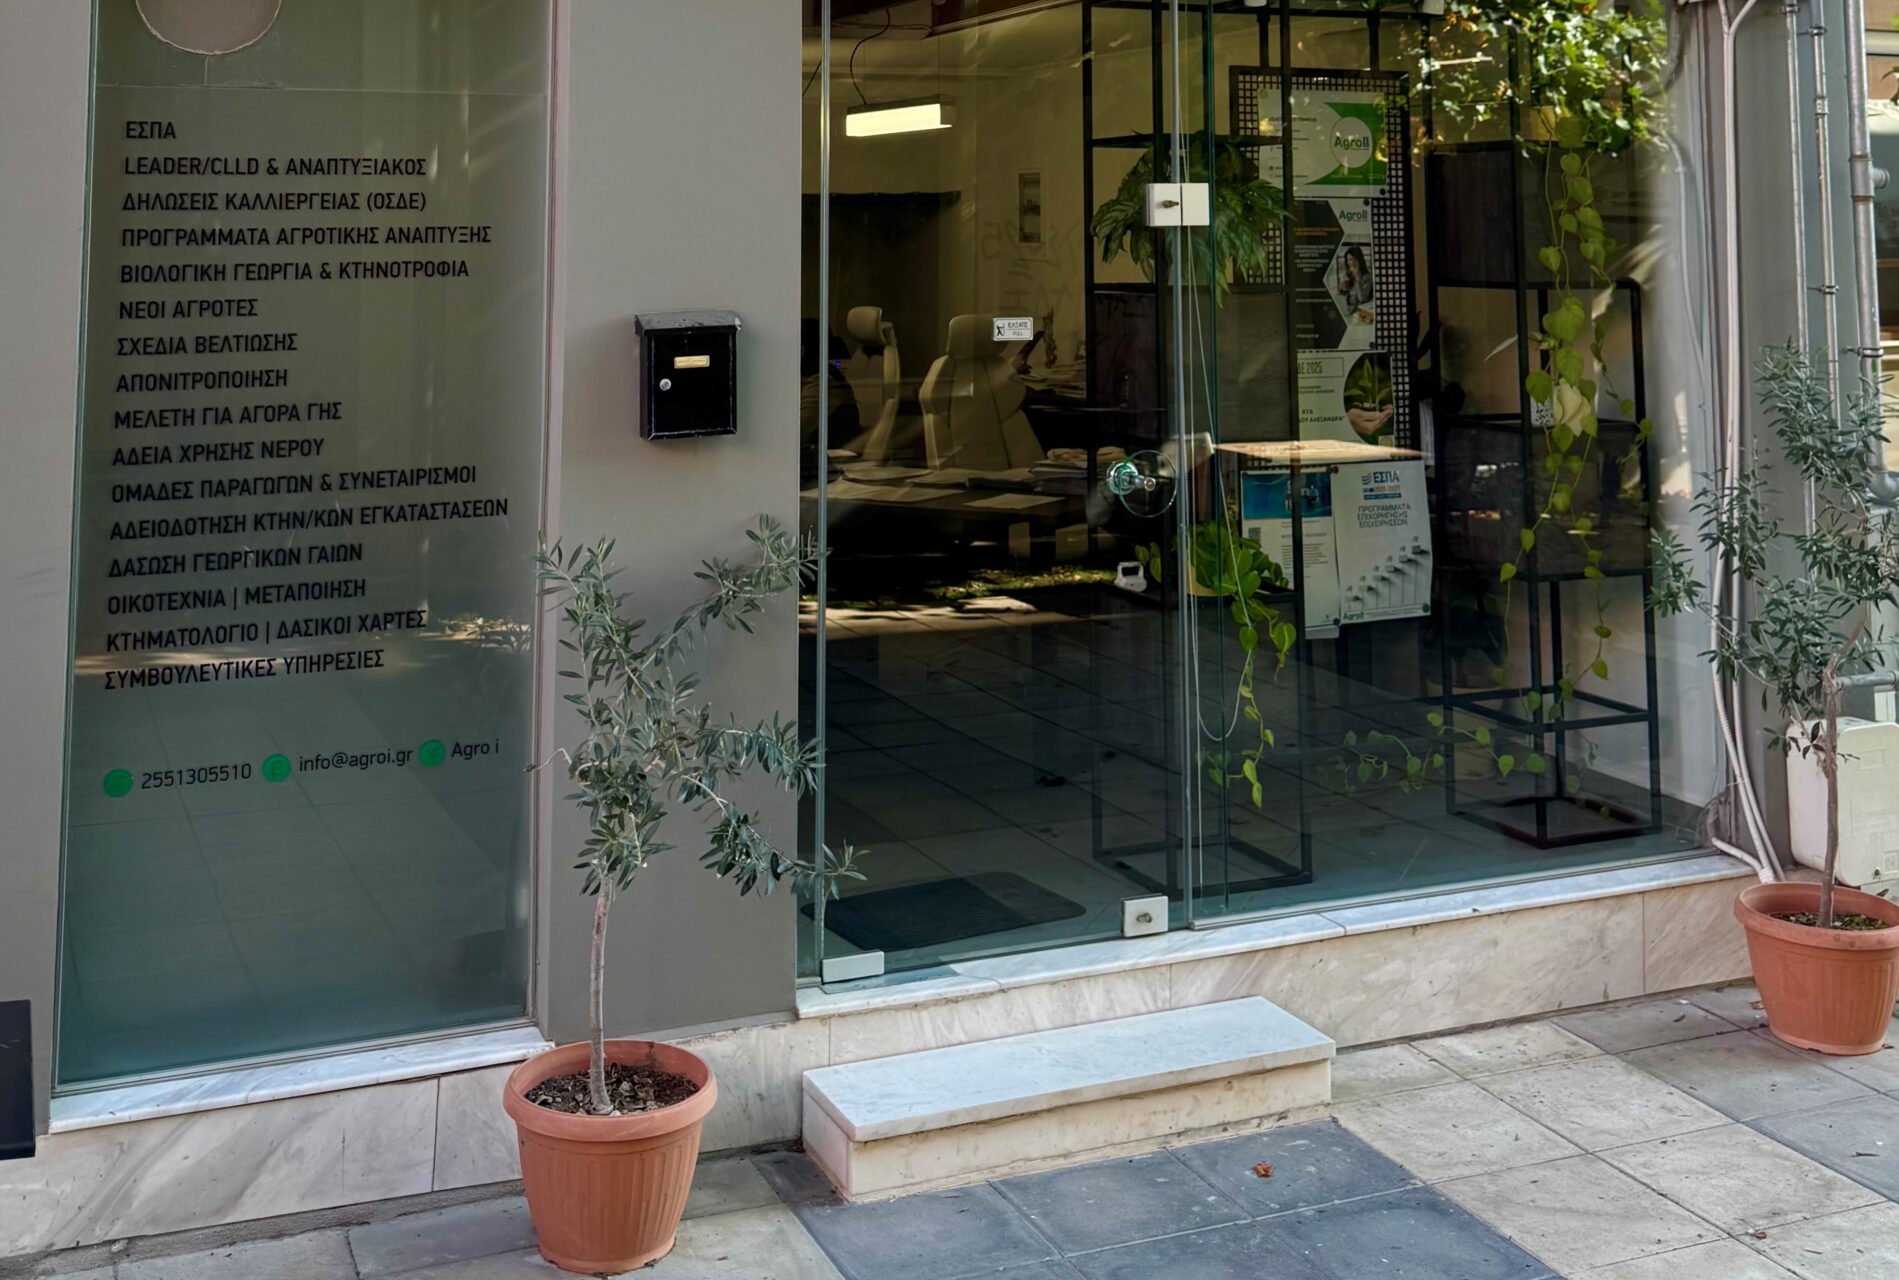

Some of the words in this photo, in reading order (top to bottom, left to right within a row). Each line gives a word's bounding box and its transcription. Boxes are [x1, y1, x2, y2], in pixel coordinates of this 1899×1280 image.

[126, 122, 176, 139] ΕΣΠΑ
[124, 157, 259, 175] LEADER/CLLD
[267, 158, 278, 175] &
[285, 158, 426, 175] ΑΝΑΠΤΥΞΙΑΚΟΣ
[122, 193, 219, 210] ΔΗΛΩΣΕΙΣ
[225, 193, 360, 210] ΚΑΛΛΙΕΡΓΕΙΑΣ
[366, 192, 426, 211] (ΟΣΔΕ)
[122, 228, 270, 247] ΠΡΟΓΡΑΜΜΑΤΑ
[276, 227, 379, 245] ΑΓΡΟΤΙΚΗΣ
[386, 226, 491, 244] ΑΝΑΠΤΥΞΗΣ
[121, 264, 225, 283] ΒΙΟΛΟΓΙΚΗ
[234, 263, 312, 281] ΓΕΩΡΓΙΑ
[320, 262, 331, 279] &
[339, 260, 469, 279] ΚΤΗΝΟΤΡΟΦΙΑ
[120, 301, 165, 319] ΝΕΟΙ
[173, 299, 258, 317] ΑΓΡΟΤΕΣ
[117, 337, 188, 356] ΣΧΕΔΙΑ
[195, 334, 297, 353] ΒΕΛΤΙΩΣΗΣ
[116, 369, 287, 392] ΑΠΟΝΙΤΡΟΠΟΙΗΣΗ
[114, 408, 195, 429] ΜΕΛΕΤΗ
[203, 407, 233, 425] ΓΙΑ
[239, 404, 300, 424] ΑΓΟΡΑ
[308, 402, 342, 420] ΓΗΣ
[113, 445, 172, 466] ΑΔΕΙΑ
[179, 442, 254, 462] ΧΡΗΣΗΣ
[261, 439, 324, 458] ΝΕΡΟΥ
[112, 482, 194, 503] ΟΜΑΔΕΣ
[201, 477, 312, 499] ΠΑΡΑΓΩΓΩΝ
[320, 475, 332, 491] &
[339, 466, 476, 490] ΣΥΝΕΤΑΙΡΙΣΜΟΙ
[1373, 471, 1400, 483] ΕΣΠΑ
[110, 515, 246, 540] ΑΔΕΙΟΔΟΤΗΣΗ
[254, 509, 353, 532] ΚΤΗΝ/ΚΩΝ
[360, 498, 508, 524] ΕΓΚΑΤΑΣΤΑΣΕΩΝ
[109, 555, 185, 577] ΔΑΣΩΣΗ
[193, 548, 300, 572] ΓΕΩΡΓΙΚΩΝ
[308, 543, 362, 565] ΓΑΙΩΝ
[108, 589, 225, 614] ΟΙΚΟΤΕΧΝΙΑ
[245, 579, 366, 605] ΜΕΤΑΠΟΙΗΣΗ
[107, 624, 258, 652] ΚΤΗΜΑΤΟΛΟΓΙΟ
[277, 616, 351, 639] ΔΑΣΙΚΟΙ
[358, 610, 427, 632] ΧΑΡΤΕΣ
[105, 659, 276, 690] ΣΥΜΒΟΥΛΕΥΤΙΚΕΣ
[284, 649, 384, 674] ΥΠΗΡΕΣΙΕΣ
[141, 763, 251, 789] 2551305510
[299, 748, 413, 773] info@agroi.gr
[451, 741, 489, 759] Agro
